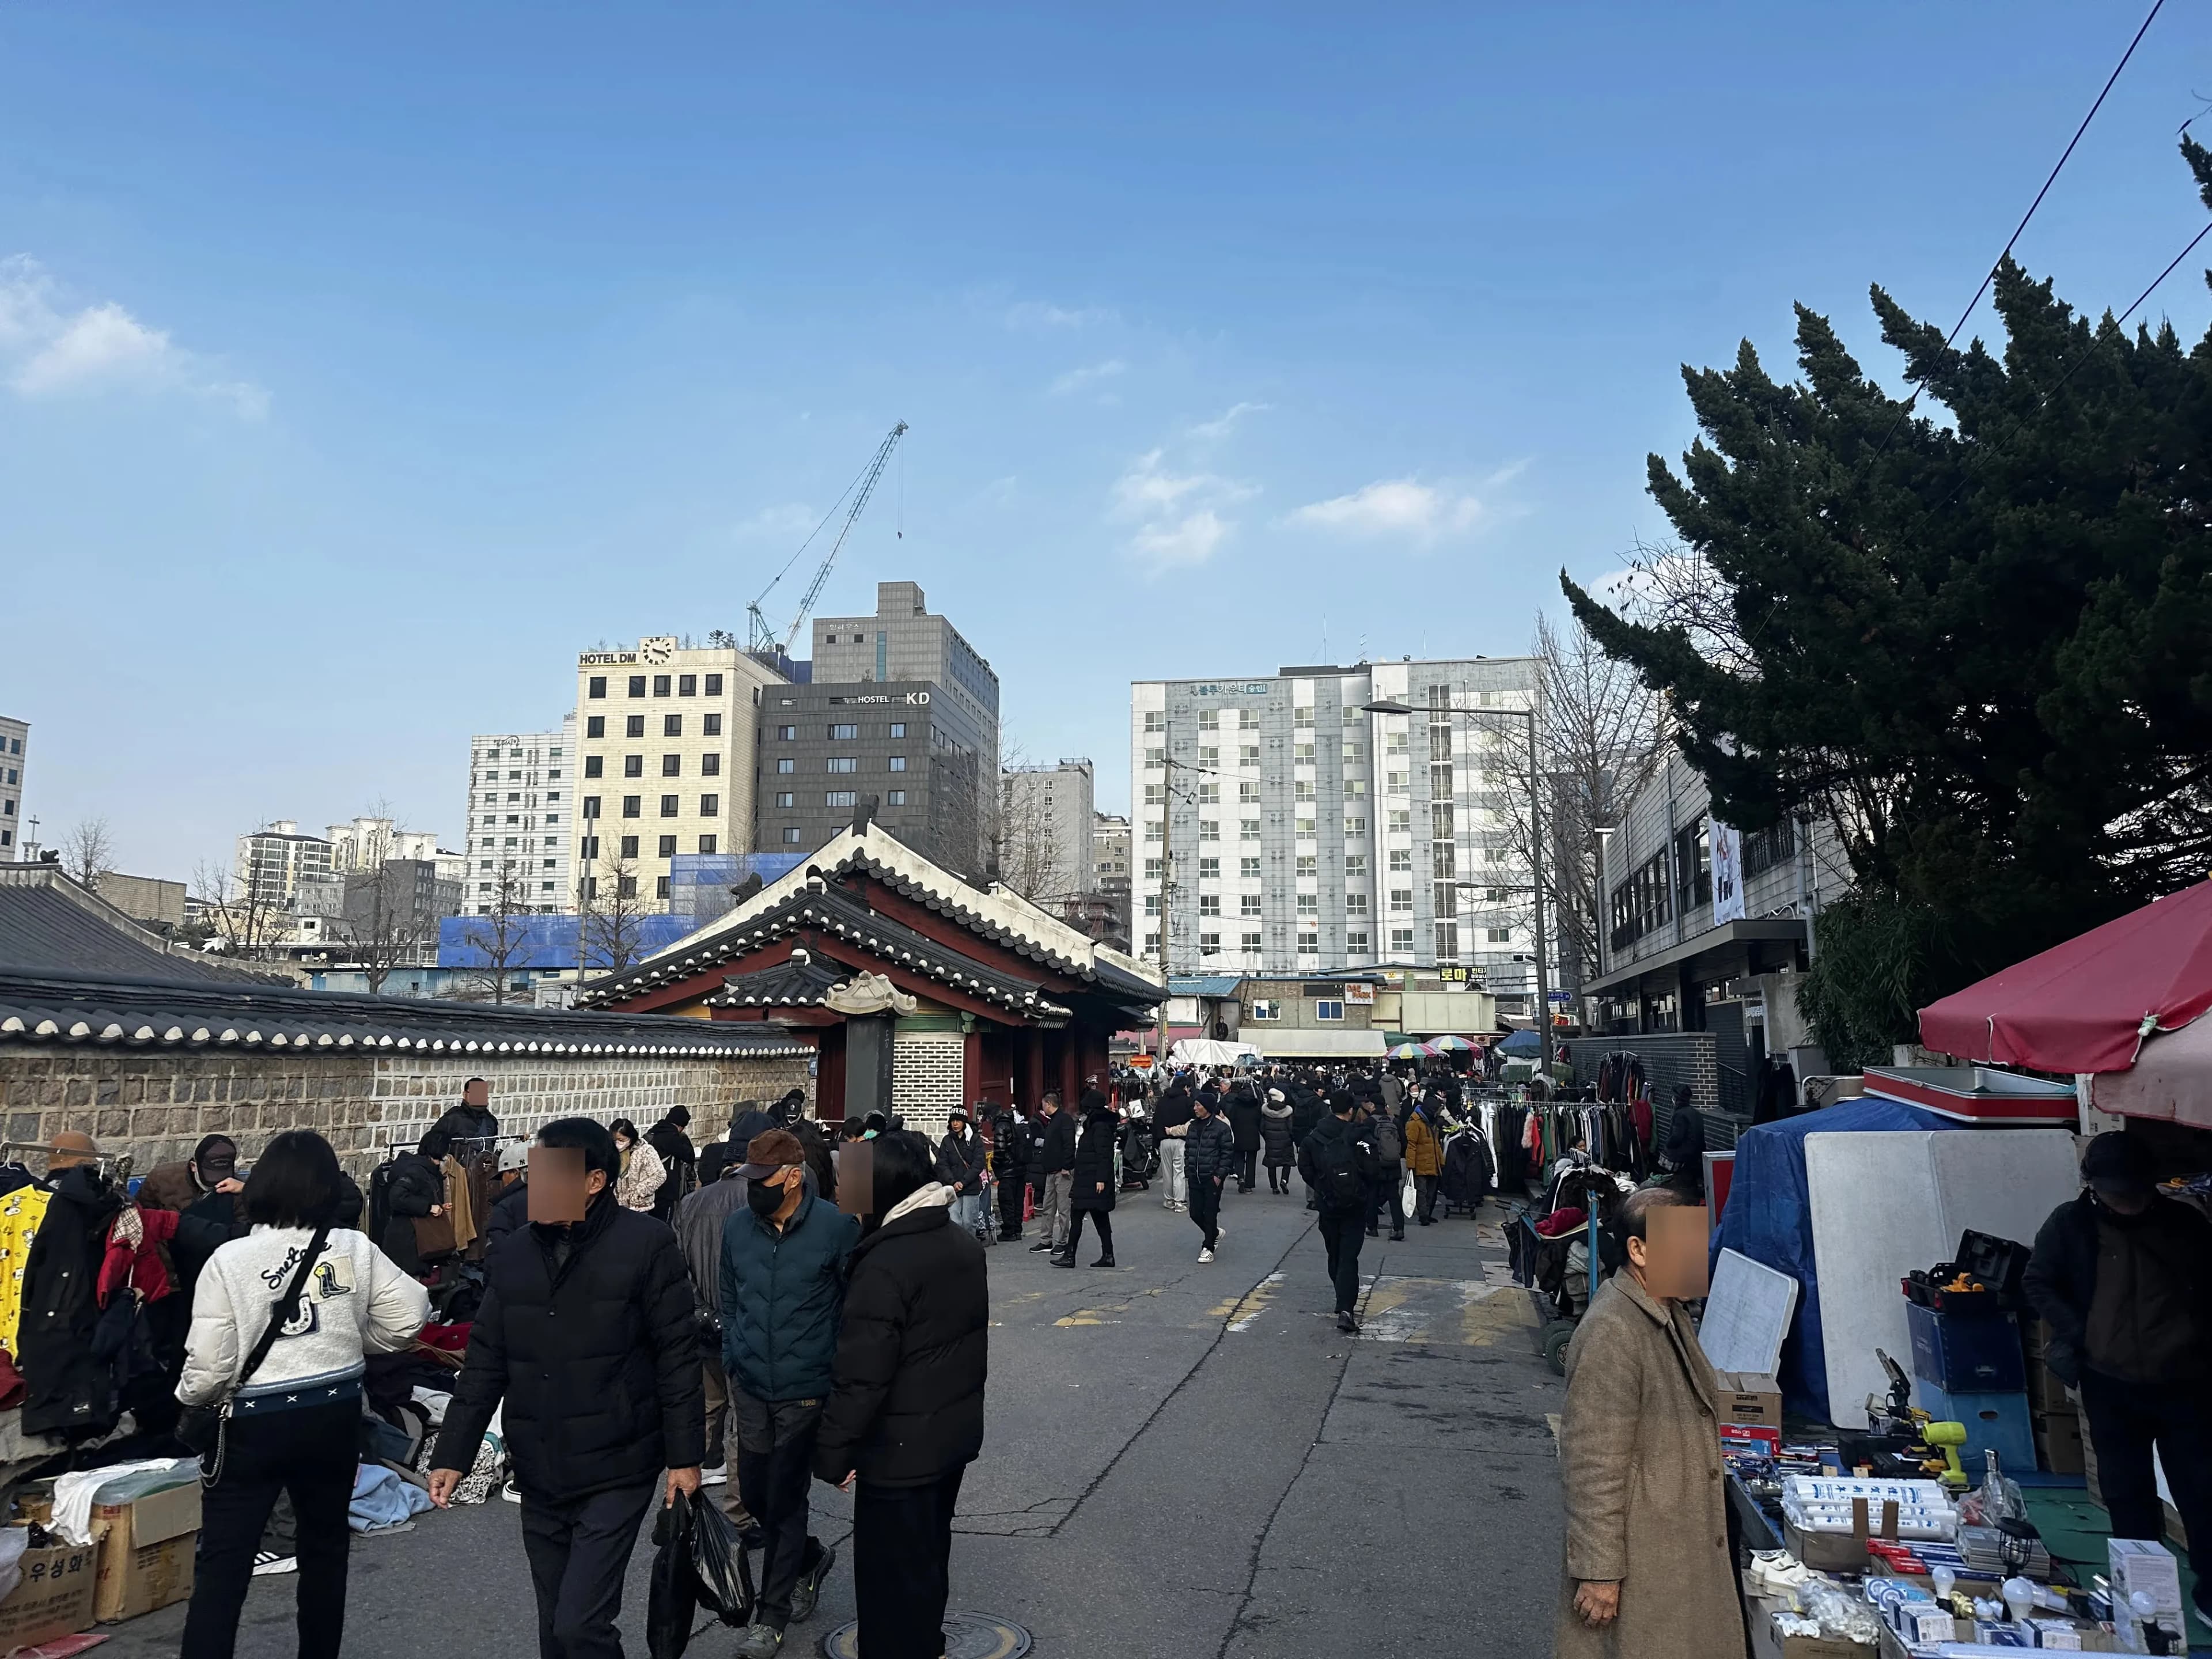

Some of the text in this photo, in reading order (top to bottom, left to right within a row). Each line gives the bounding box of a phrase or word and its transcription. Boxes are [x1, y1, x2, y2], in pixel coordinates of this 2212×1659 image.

[579, 654, 617, 664] HOTEL
[619, 653, 636, 663] DM
[1199, 684, 1247, 695] 블루카운티
[858, 692, 930, 705] HOSTEL KD
[1441, 968, 1467, 981] 로마
